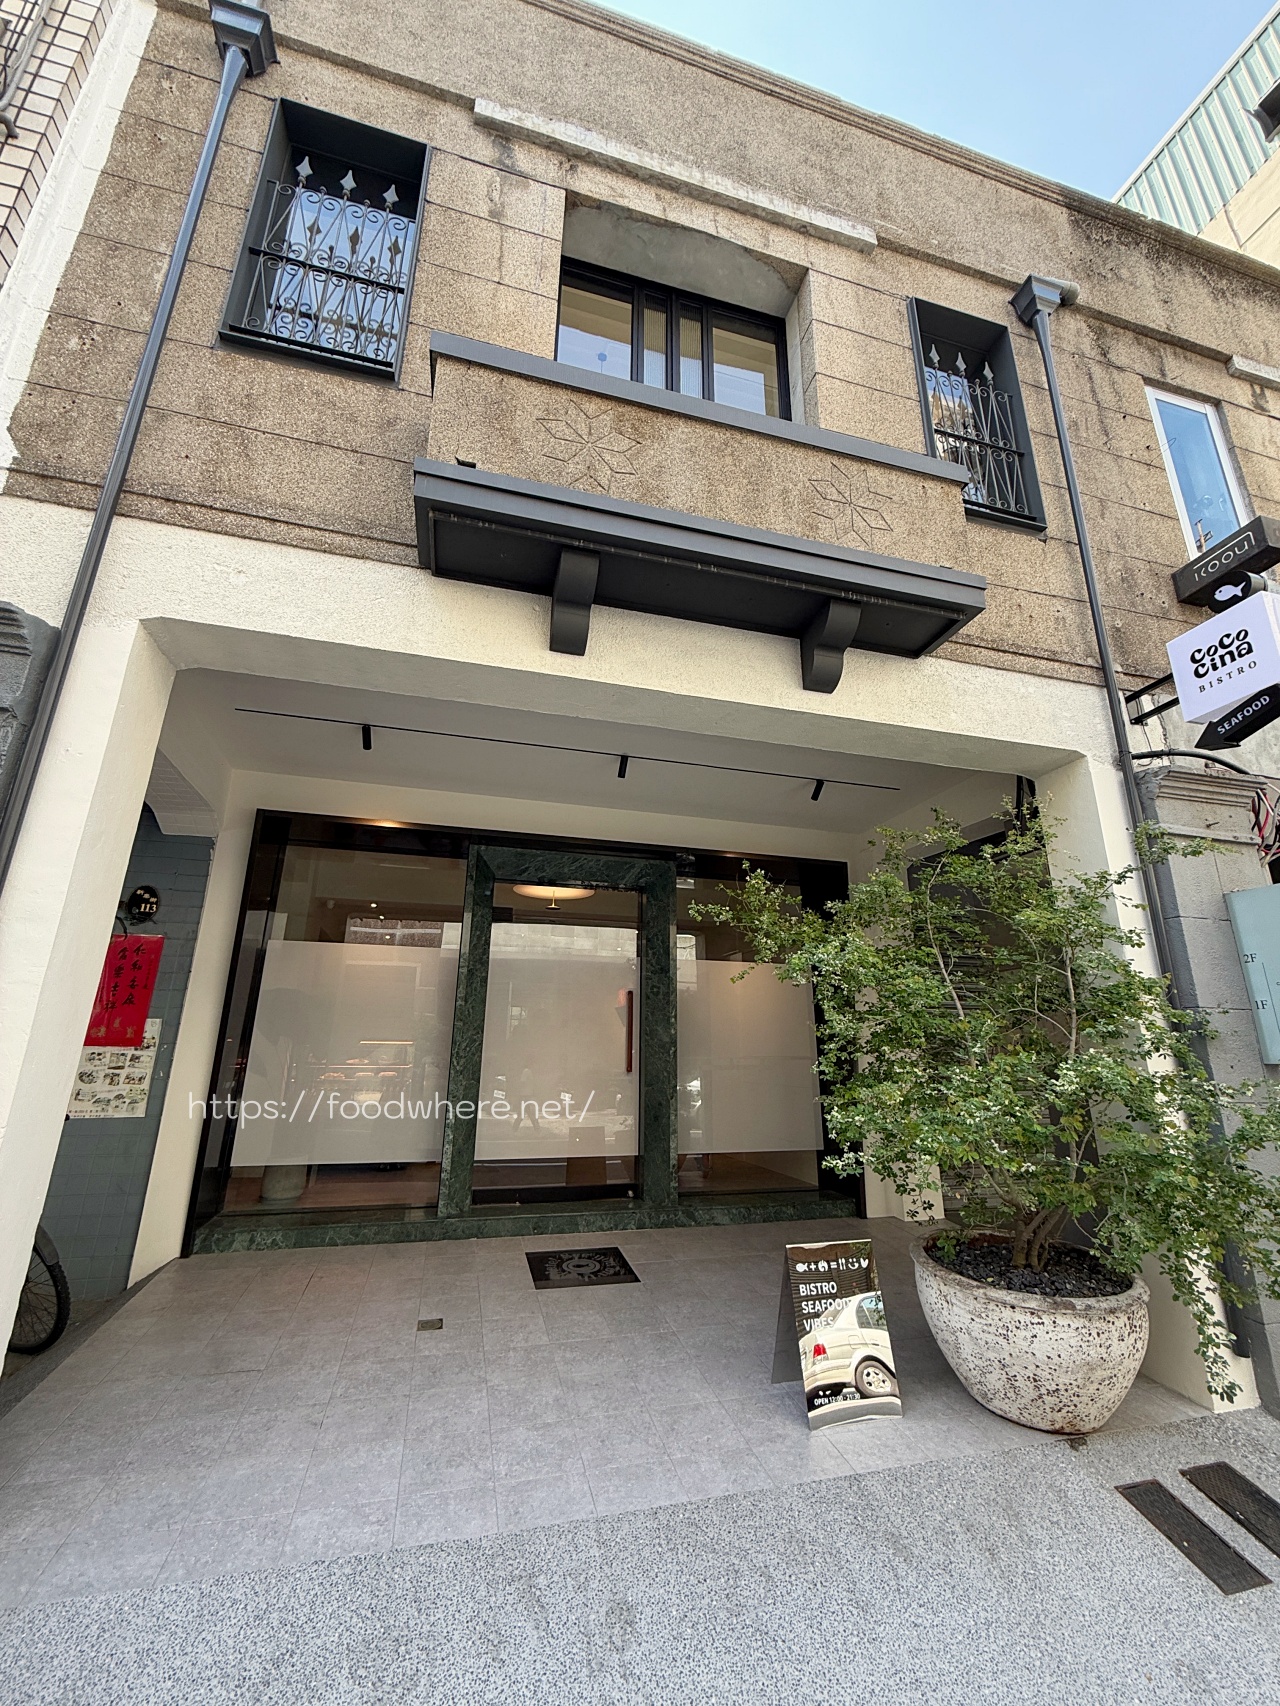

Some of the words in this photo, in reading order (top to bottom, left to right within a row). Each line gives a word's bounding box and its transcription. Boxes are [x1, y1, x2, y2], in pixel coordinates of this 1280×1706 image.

[1198, 660, 1257, 693] BISTRO
[1217, 695, 1270, 735] SEAFOOD
[140, 903, 157, 913] 113
[1243, 953, 1257, 964] 2F
[1255, 999, 1269, 1010] 1F
[799, 1281, 837, 1296] BISTRO
[801, 1298, 850, 1314] SEAFOOD
[803, 1316, 834, 1332] VIBES
[813, 1398, 829, 1406] OPEN
